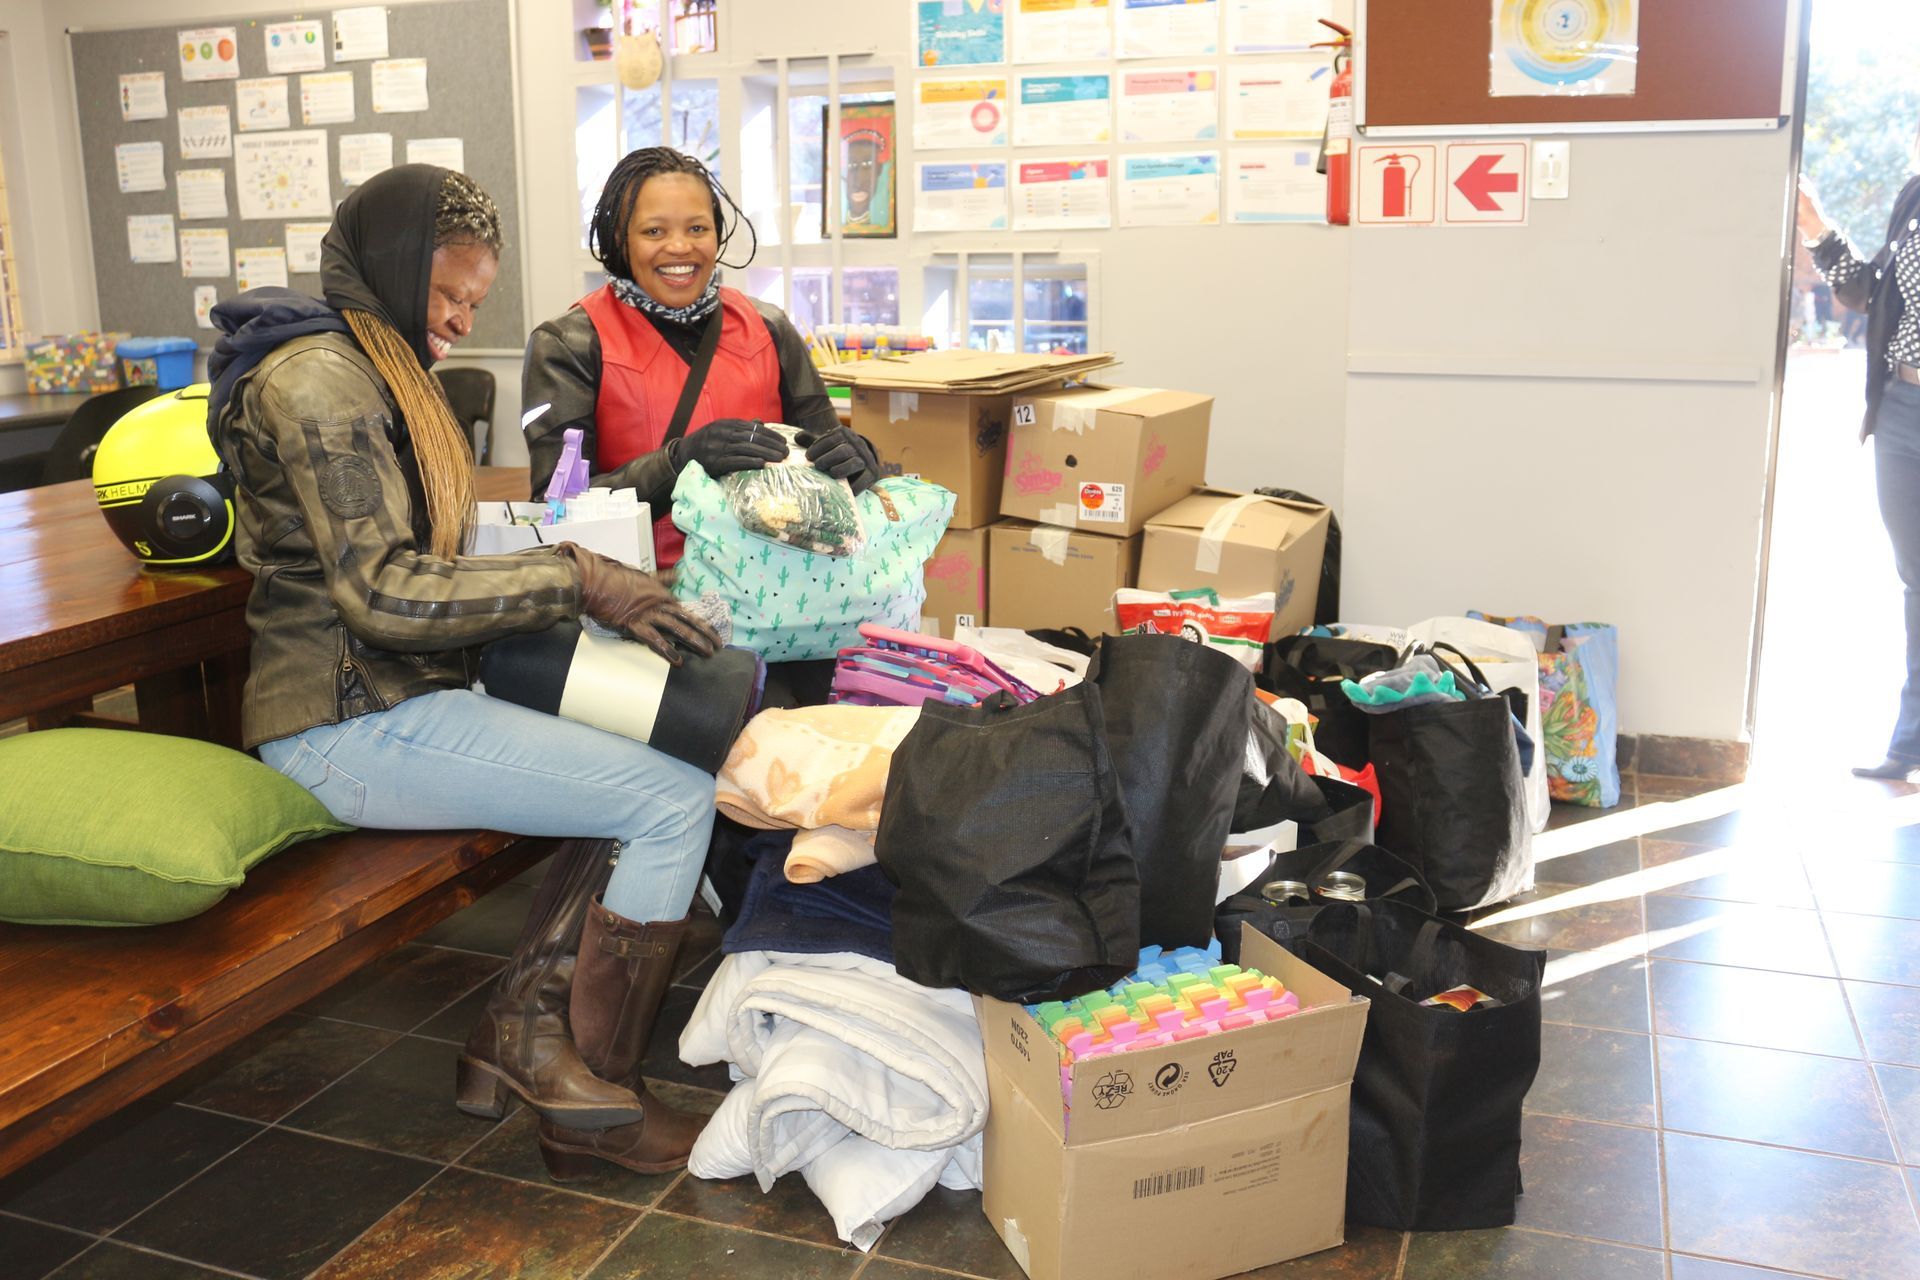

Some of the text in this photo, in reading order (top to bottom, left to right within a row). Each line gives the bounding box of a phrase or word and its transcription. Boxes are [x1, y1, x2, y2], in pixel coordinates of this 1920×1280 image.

[1016, 406, 1032, 424] 12
[1015, 468, 1063, 491] Simba
[171, 513, 197, 522] SHARK
[1213, 1048, 1234, 1062] PAP
[1216, 1065, 1229, 1075] 20
[1098, 1084, 1128, 1098] REZY
